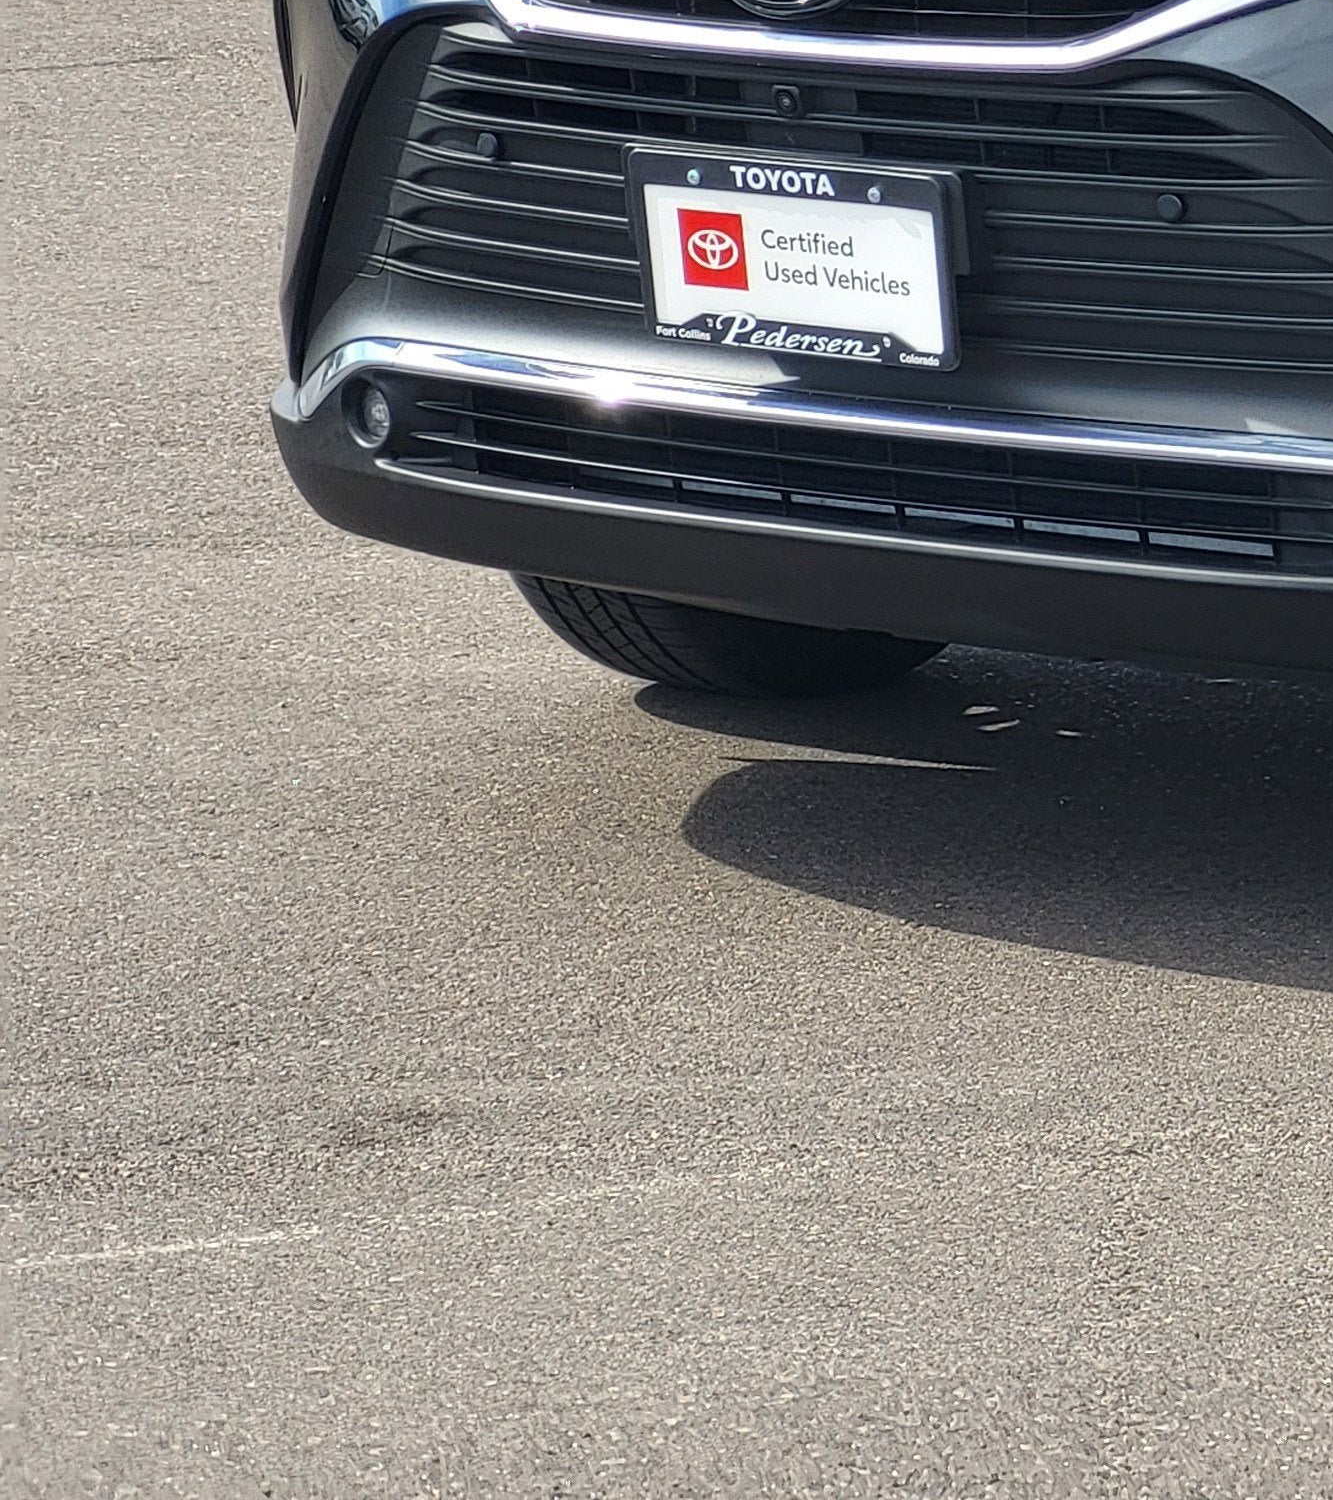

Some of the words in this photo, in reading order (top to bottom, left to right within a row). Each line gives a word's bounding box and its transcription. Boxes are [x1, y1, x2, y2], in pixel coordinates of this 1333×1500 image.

[729, 164, 835, 197] TOYOTA
[761, 229, 853, 257] Certified
[764, 261, 818, 286] Used
[823, 266, 911, 296] Vehicles
[716, 310, 881, 357] Pedersen
[899, 352, 940, 367] Colorado
